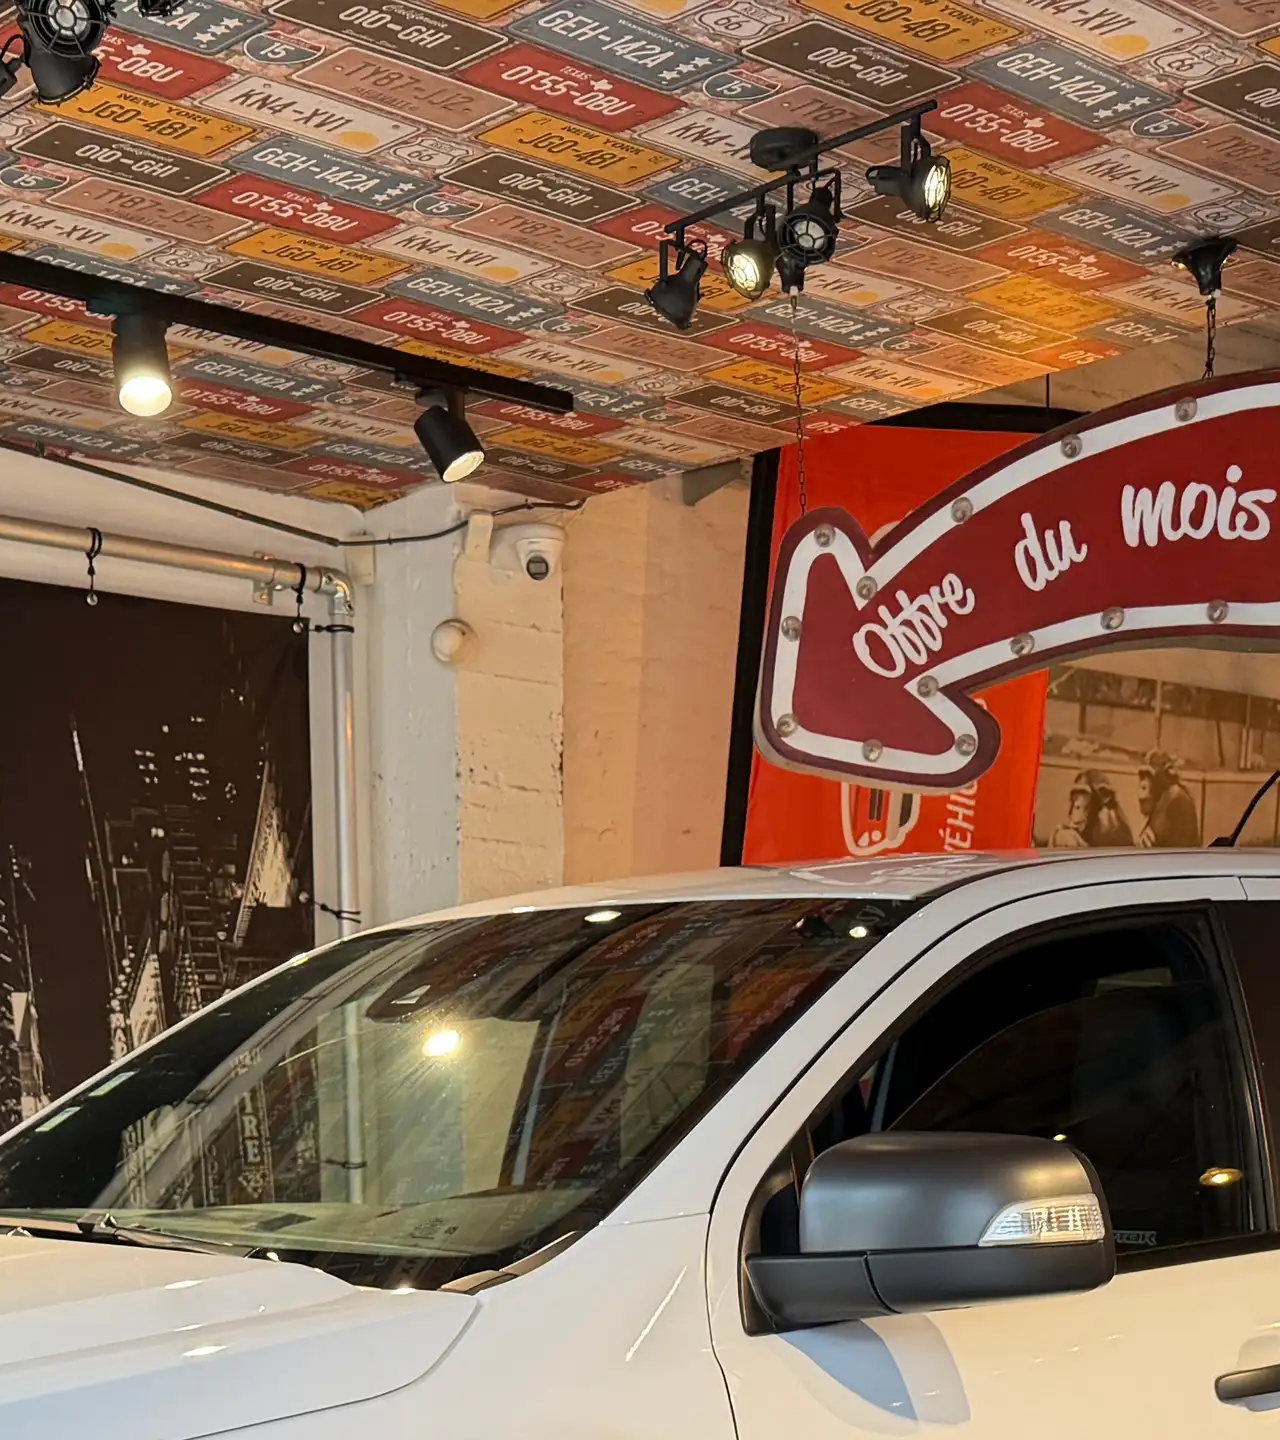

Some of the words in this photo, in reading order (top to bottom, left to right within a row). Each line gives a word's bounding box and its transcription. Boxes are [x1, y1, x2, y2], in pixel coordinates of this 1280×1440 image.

[538, 10, 675, 69] GEH-142A
[997, 52, 1119, 108] GEH-142A
[253, 148, 381, 194] GEH-142A
[1059, 208, 1161, 249] GEH-142A
[406, 276, 516, 316] GEH-142A
[764, 302, 864, 335] GEH-142A
[193, 359, 296, 392] GEH-142A
[17, 424, 112, 449] GEH-142A
[326, 441, 416, 467] GEH-142A
[853, 572, 975, 678] Offre
[1015, 512, 1088, 592] du
[1120, 464, 1278, 547] mois
